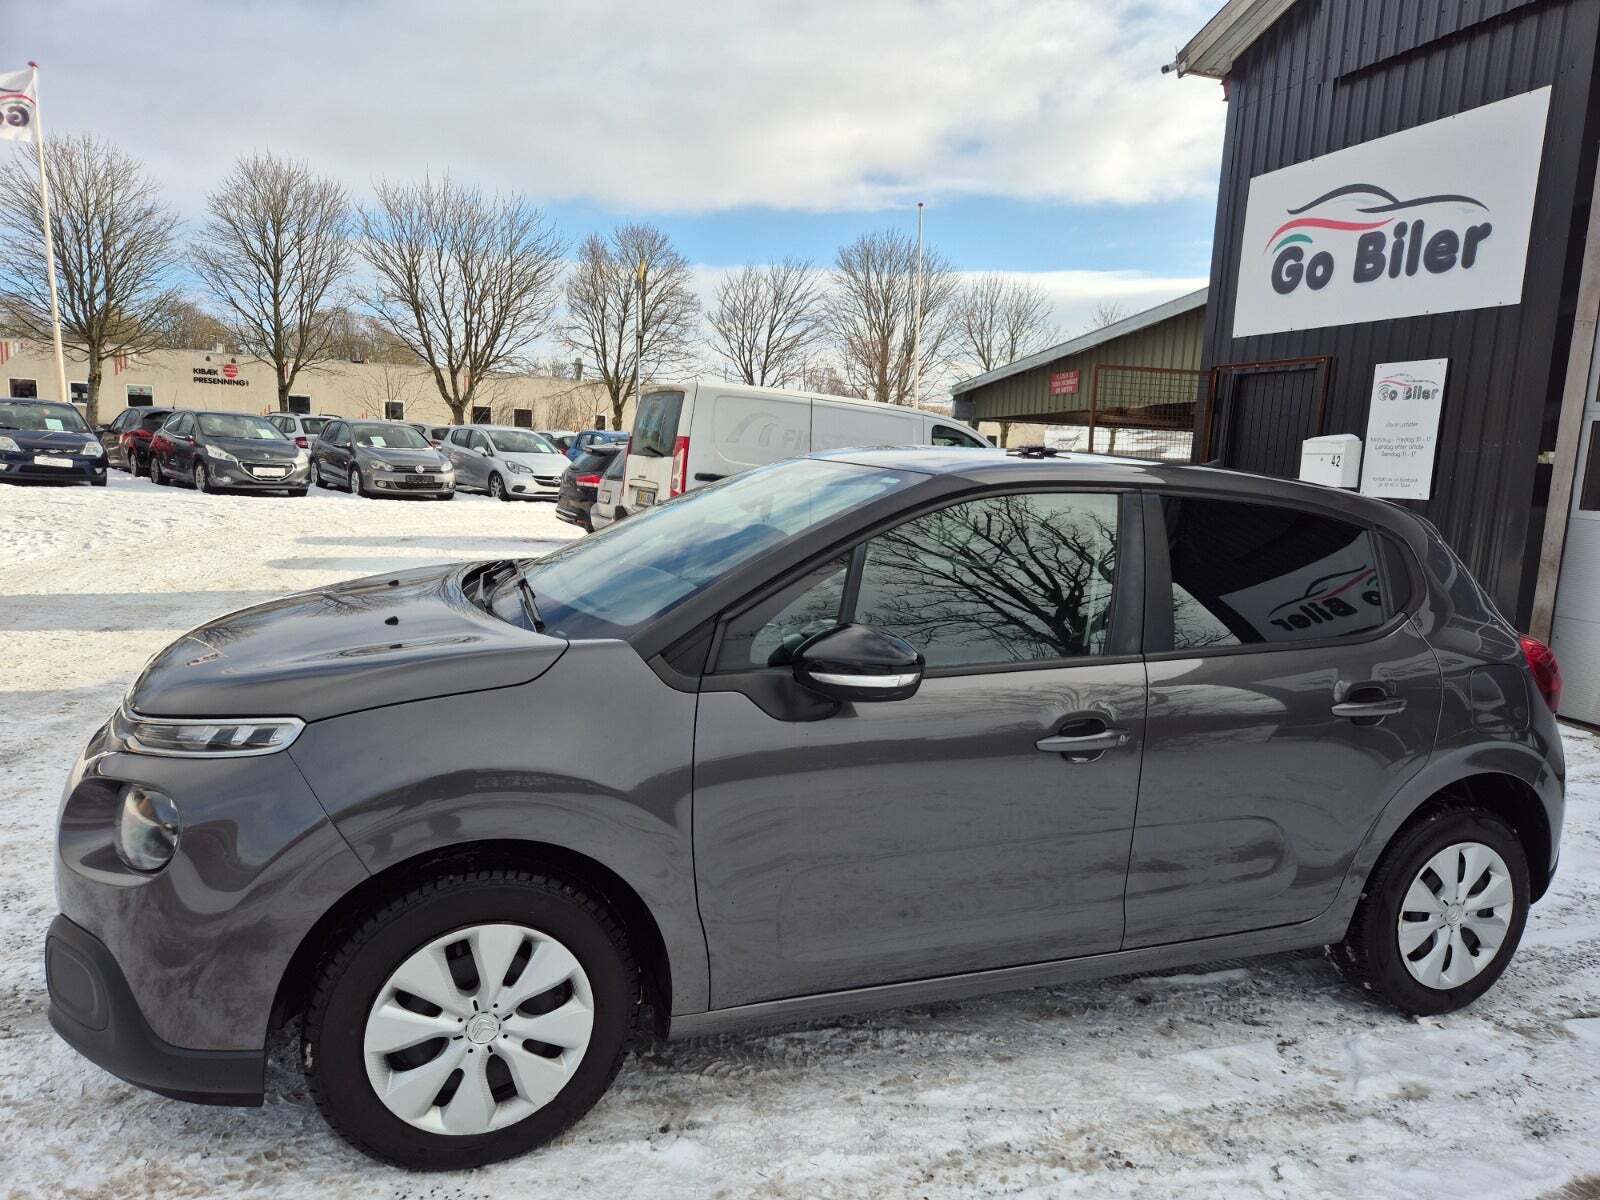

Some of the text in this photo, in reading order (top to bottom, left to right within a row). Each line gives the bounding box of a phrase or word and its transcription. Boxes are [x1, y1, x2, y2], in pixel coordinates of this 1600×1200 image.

[1271, 219, 1493, 295] Go Biler
[193, 368, 218, 376] KIBÆK
[1402, 385, 1440, 401] Biler
[1331, 455, 1341, 467] 42
